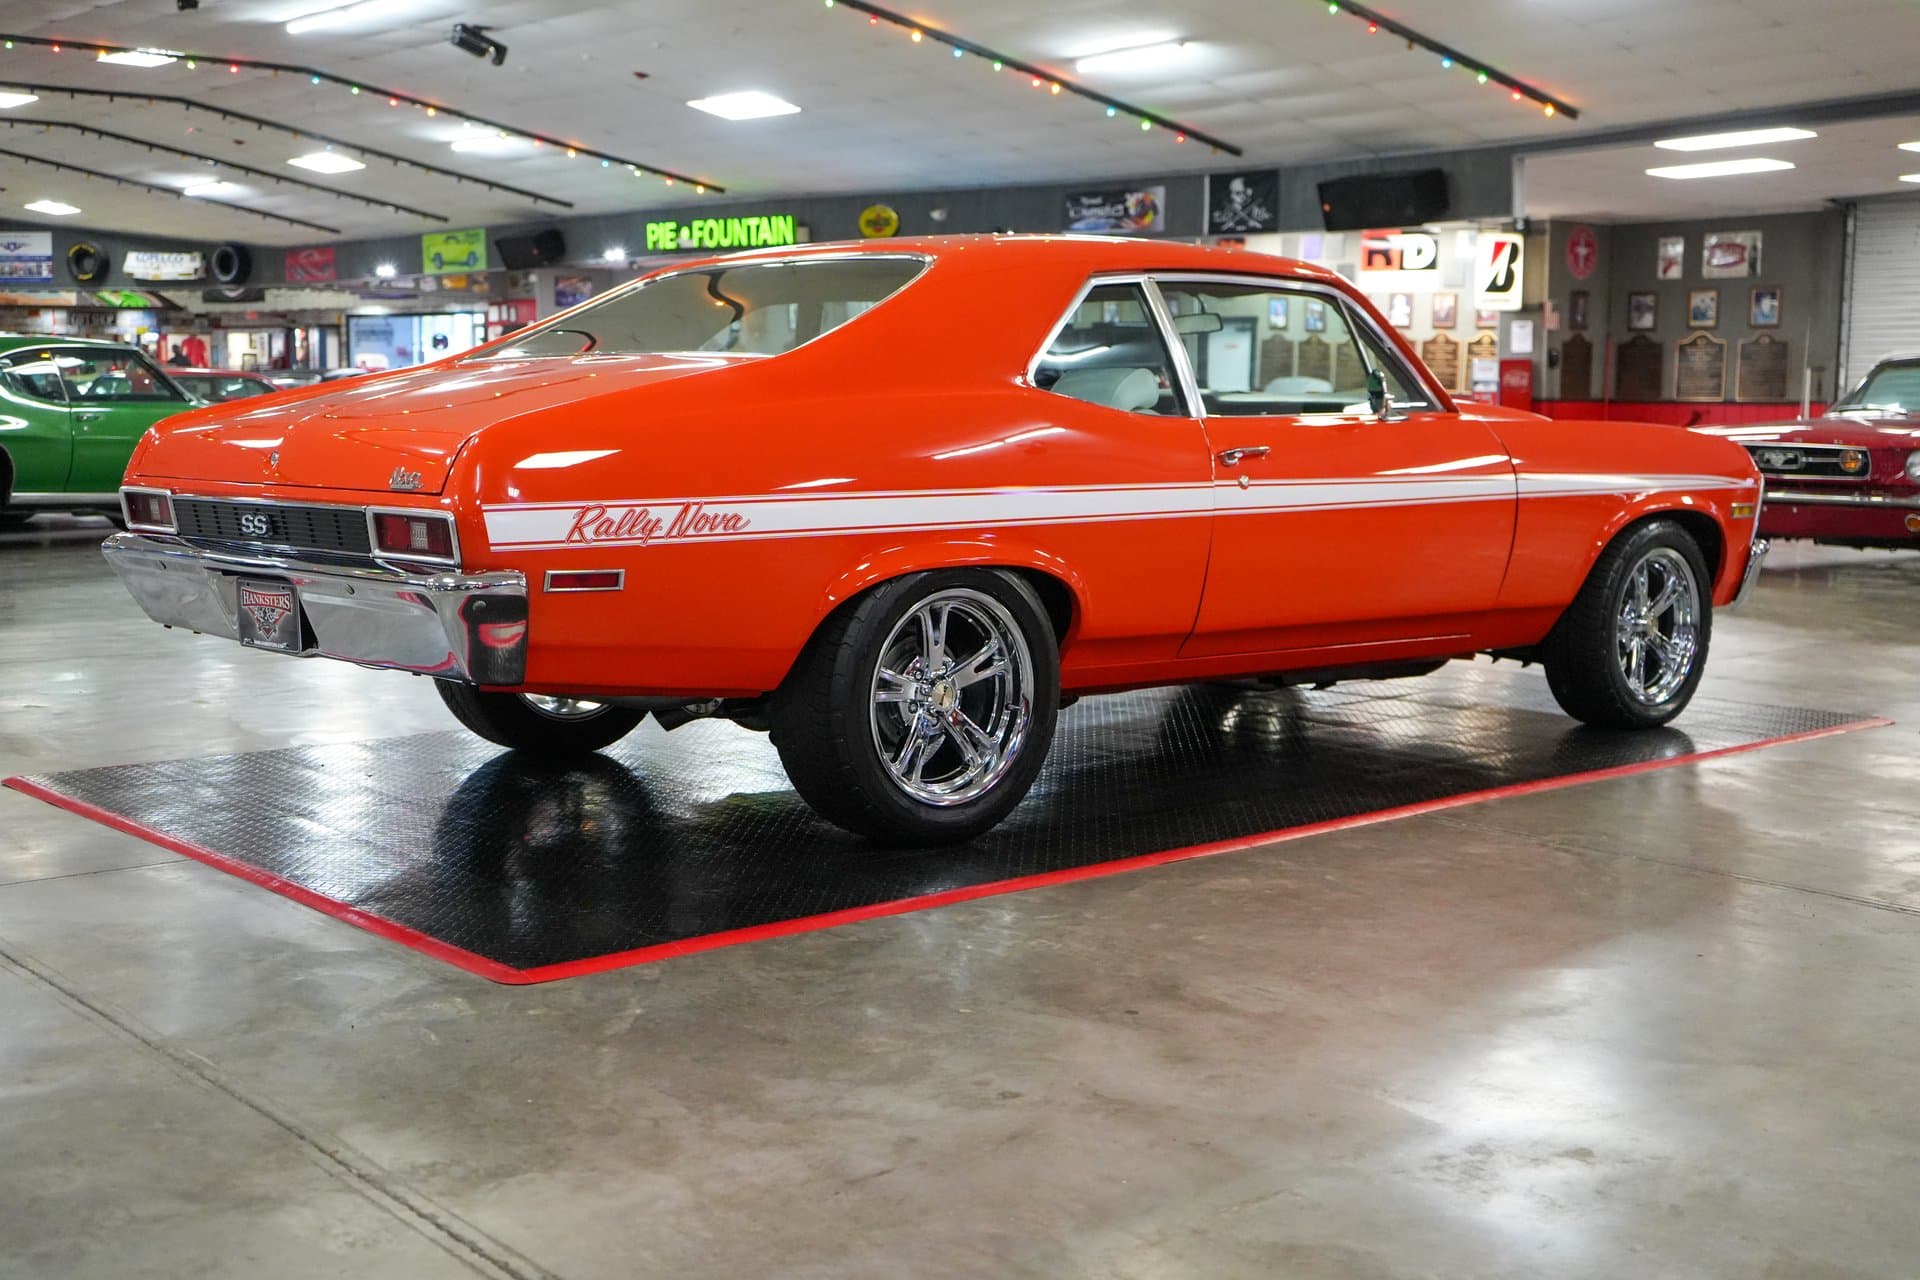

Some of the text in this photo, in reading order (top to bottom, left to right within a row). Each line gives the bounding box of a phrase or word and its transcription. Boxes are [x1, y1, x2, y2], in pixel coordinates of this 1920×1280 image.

[646, 215, 794, 250] PIE FOUNTAIN
[241, 513, 268, 535] SS
[565, 501, 751, 547] Rally Nova
[242, 590, 291, 611] HANKSTERS
